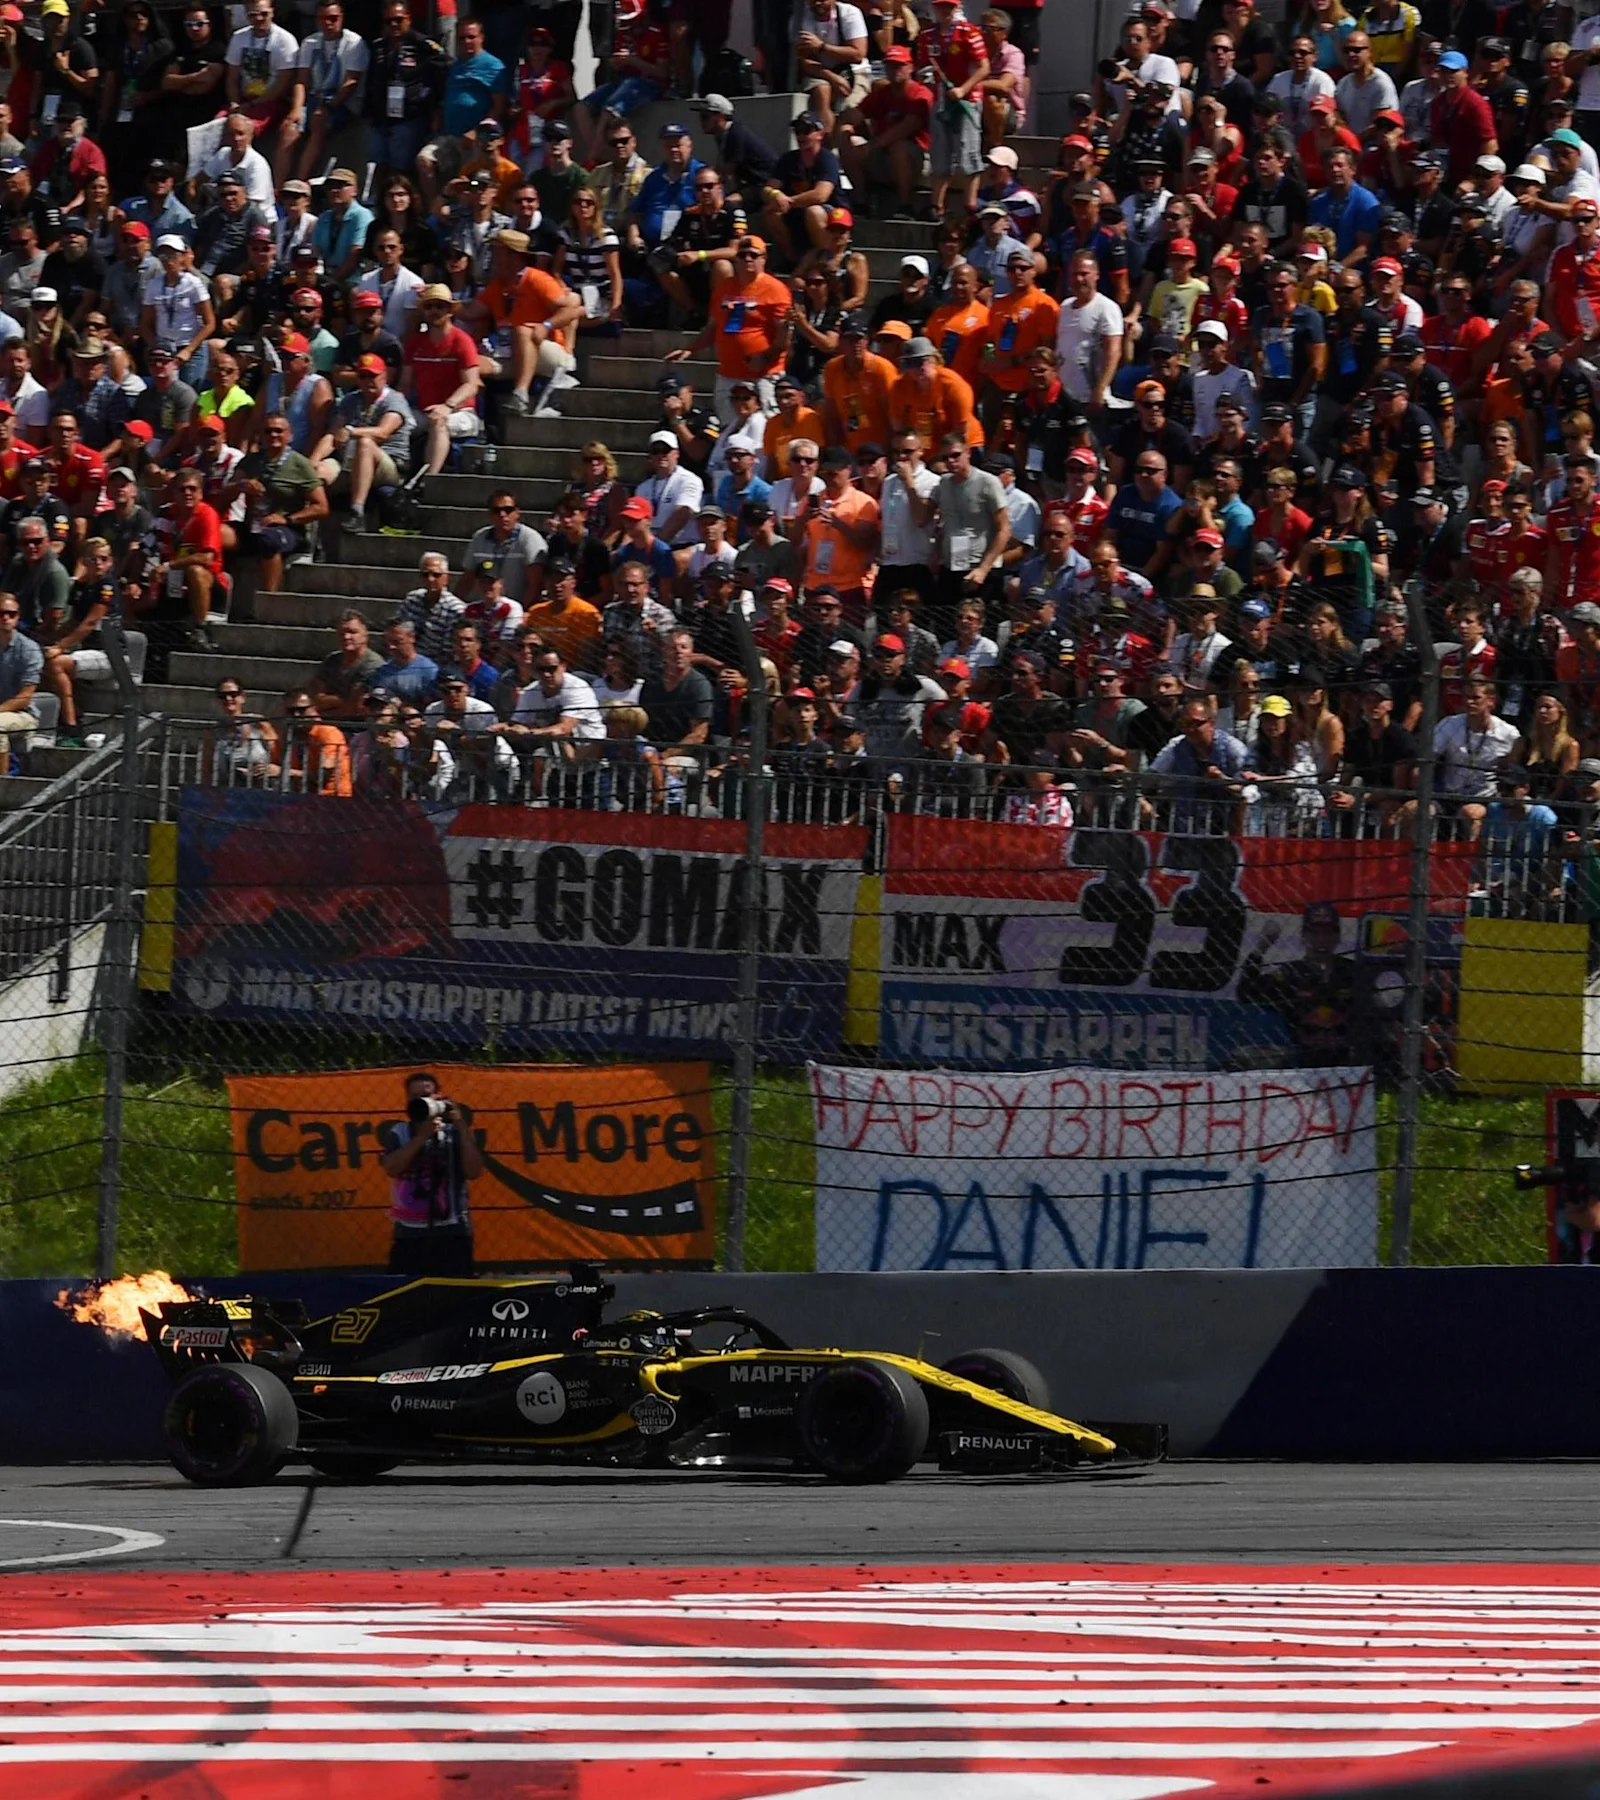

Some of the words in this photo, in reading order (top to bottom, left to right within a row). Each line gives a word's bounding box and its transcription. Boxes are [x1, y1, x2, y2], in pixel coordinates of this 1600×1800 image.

[467, 846, 827, 954] #GOMAX
[1060, 831, 1247, 991] 33
[893, 912, 1006, 971] MAX
[241, 965, 315, 1012] MAX
[321, 975, 526, 1026] VERSTAPPEN
[530, 990, 643, 1036] LATEST
[646, 996, 740, 1041] NEWS
[888, 998, 1209, 1071] VERSTAPPEN
[516, 1100, 704, 1164] More
[810, 1066, 1027, 1154] HAPPY
[1043, 1070, 1374, 1164] BIRTHDAY
[176, 1329, 223, 1345] Castrol
[330, 1306, 381, 1345] 27
[469, 1327, 547, 1340] INFINITI
[389, 1368, 427, 1383] Castrol
[427, 1363, 493, 1382] EDGE
[729, 1364, 824, 1384] MAPFR
[404, 1397, 457, 1411] RENAULT
[754, 1406, 795, 1416] Microsoft
[959, 1436, 1032, 1451] RENAULT
